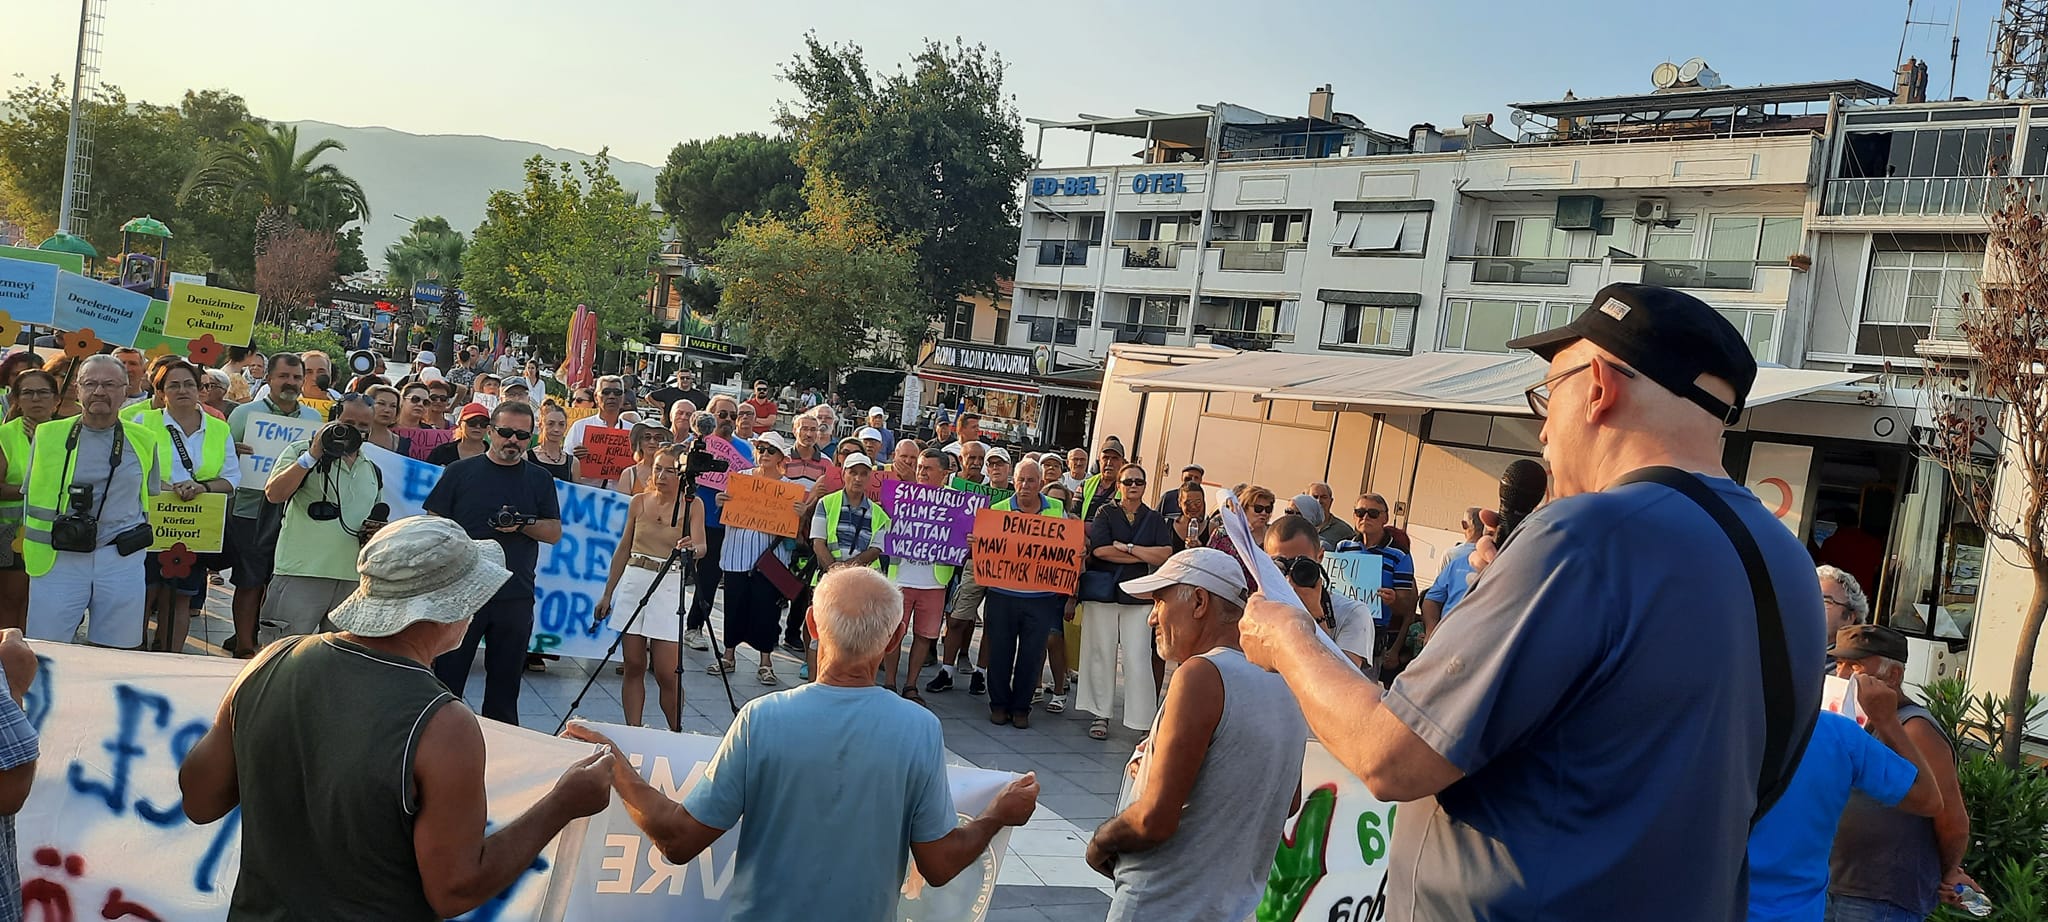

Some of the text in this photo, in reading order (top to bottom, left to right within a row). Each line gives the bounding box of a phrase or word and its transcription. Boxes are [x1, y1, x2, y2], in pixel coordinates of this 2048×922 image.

[1032, 173, 1187, 196] ED-BEL OTEL
[187, 294, 246, 311] Denizimize
[200, 308, 225, 320] Sahip
[186, 317, 234, 333] Çıkalım!
[691, 339, 728, 353] WAFFLE
[934, 346, 1030, 375] ROMA TADIM DONDURMA
[250, 455, 276, 473] TE
[157, 503, 203, 514] Edremit
[163, 517, 195, 526] Körfezi
[155, 526, 201, 541] Ölüyor!
[1017, 543, 1076, 567] VATANDIR
